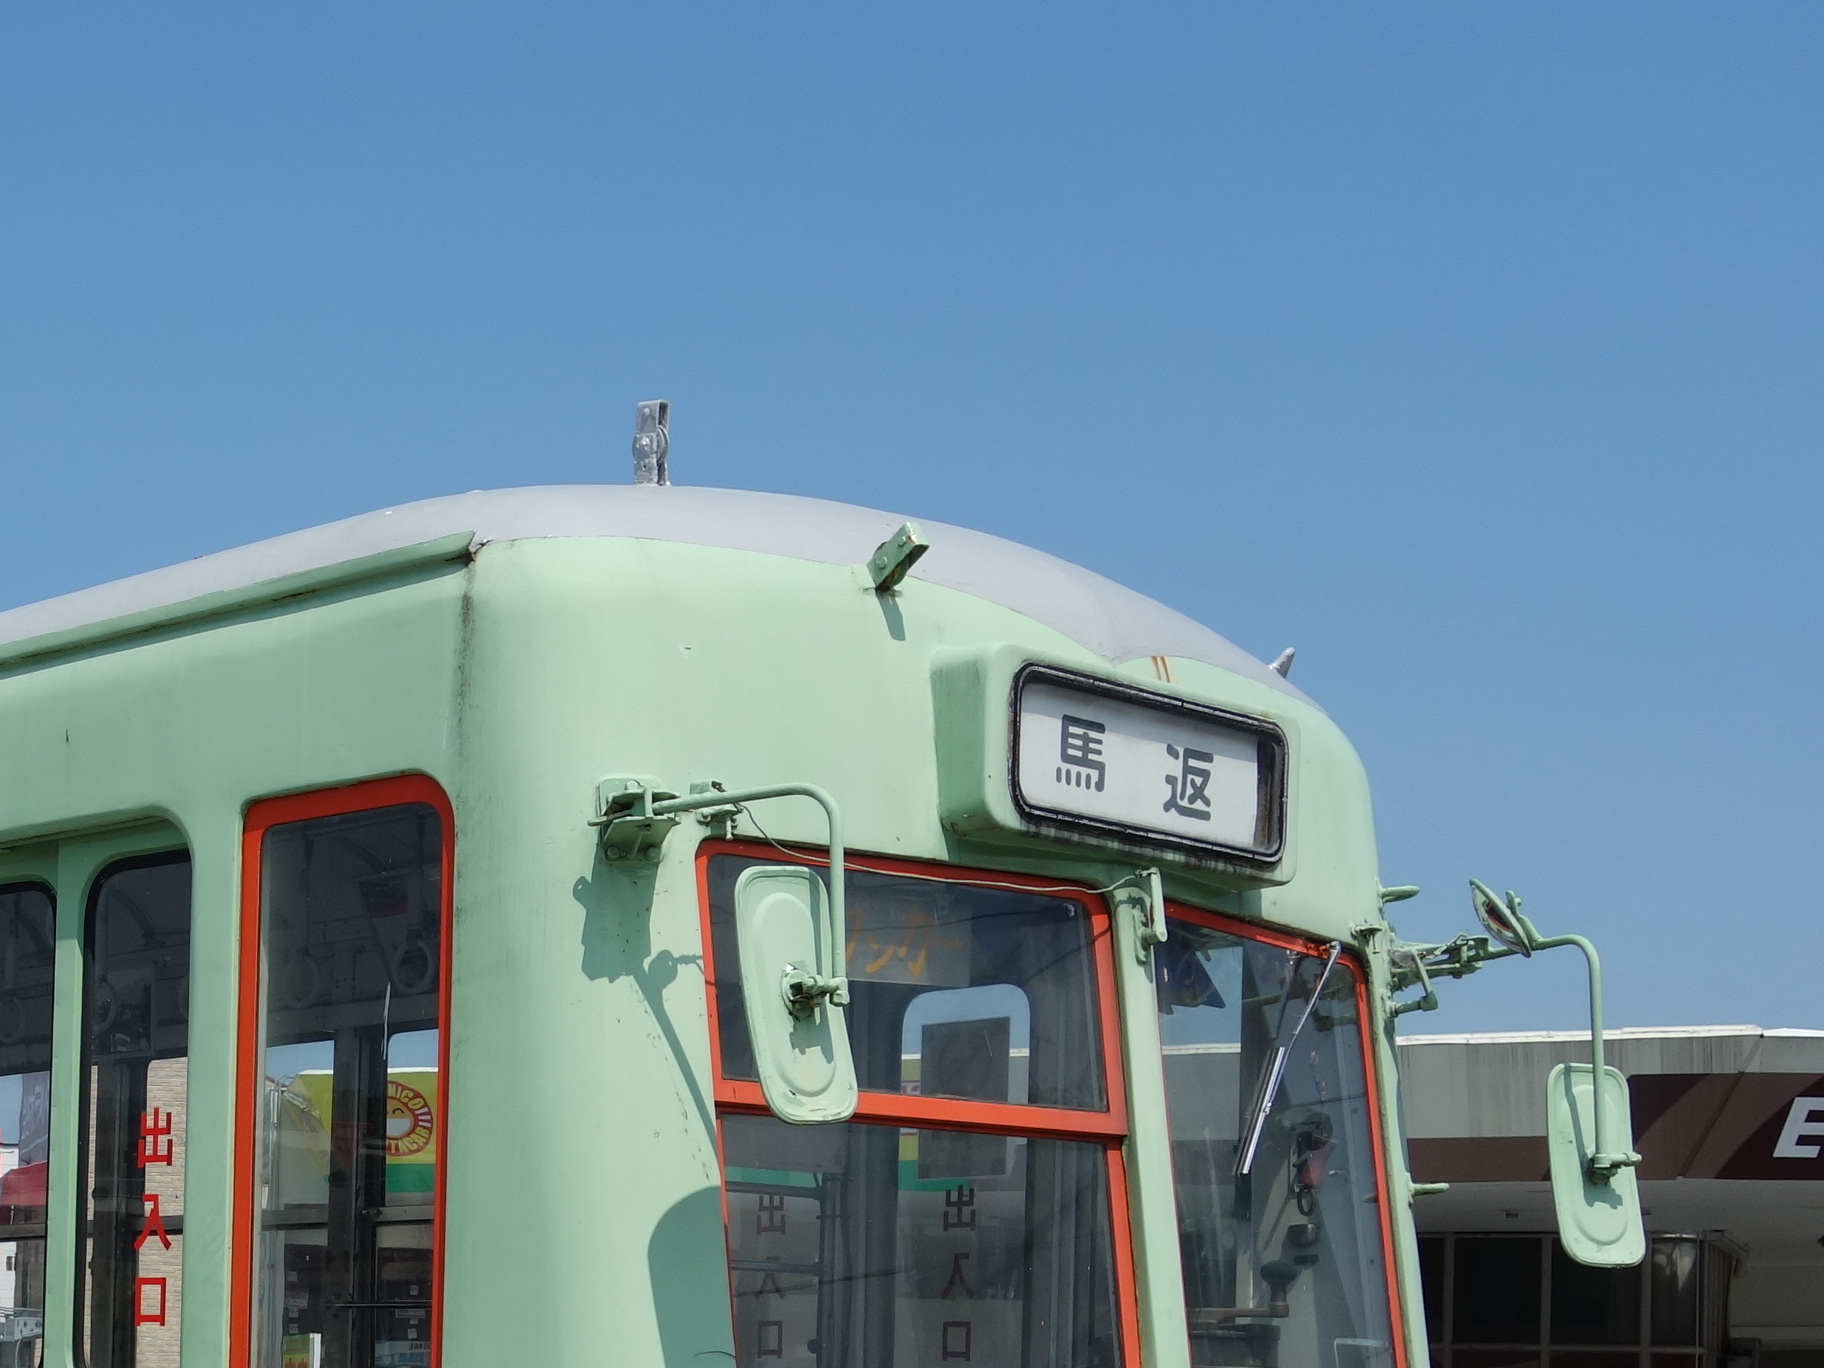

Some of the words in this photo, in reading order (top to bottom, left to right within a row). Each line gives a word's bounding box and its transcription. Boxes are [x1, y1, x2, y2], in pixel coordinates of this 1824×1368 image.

[1055, 713, 1215, 822] 馬返
[386, 1126, 430, 1154] TACAR
[1772, 1096, 1824, 1158] E
[133, 1107, 174, 1327] 出入口
